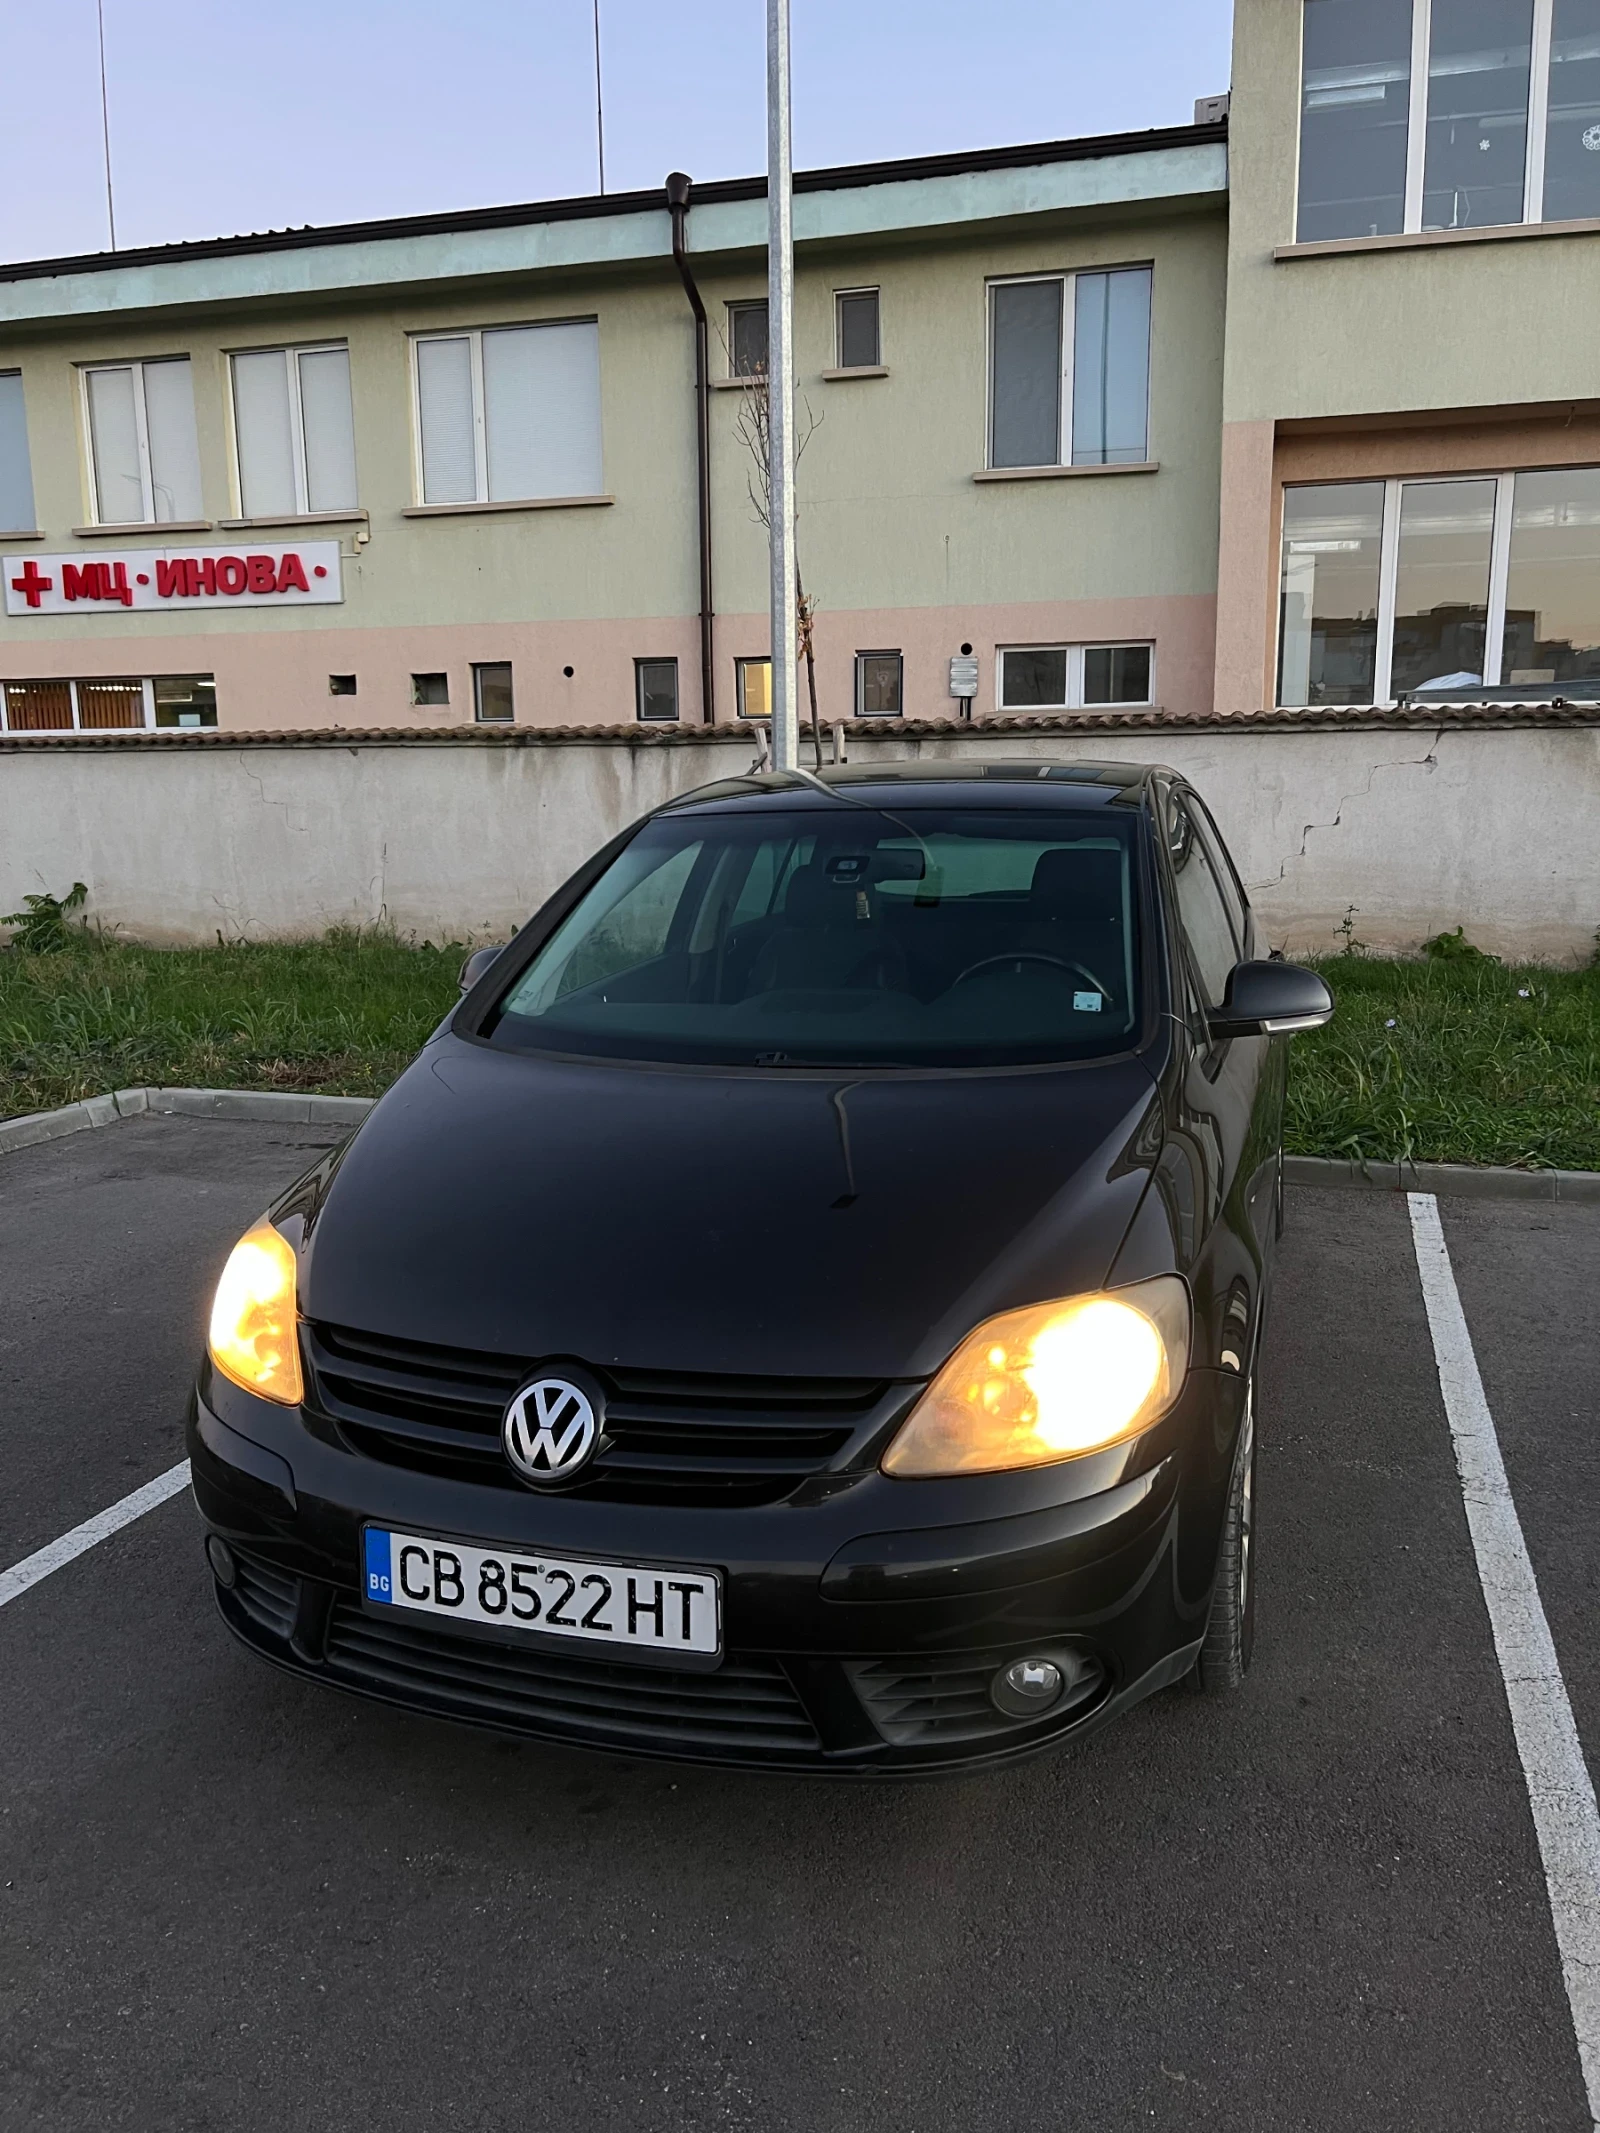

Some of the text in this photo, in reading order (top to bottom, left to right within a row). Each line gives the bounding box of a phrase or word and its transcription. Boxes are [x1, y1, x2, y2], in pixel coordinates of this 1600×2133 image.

[62, 554, 310, 606] МЦ ИНОВА
[370, 1573, 390, 1592] BG
[478, 1559, 613, 1632] 8522
